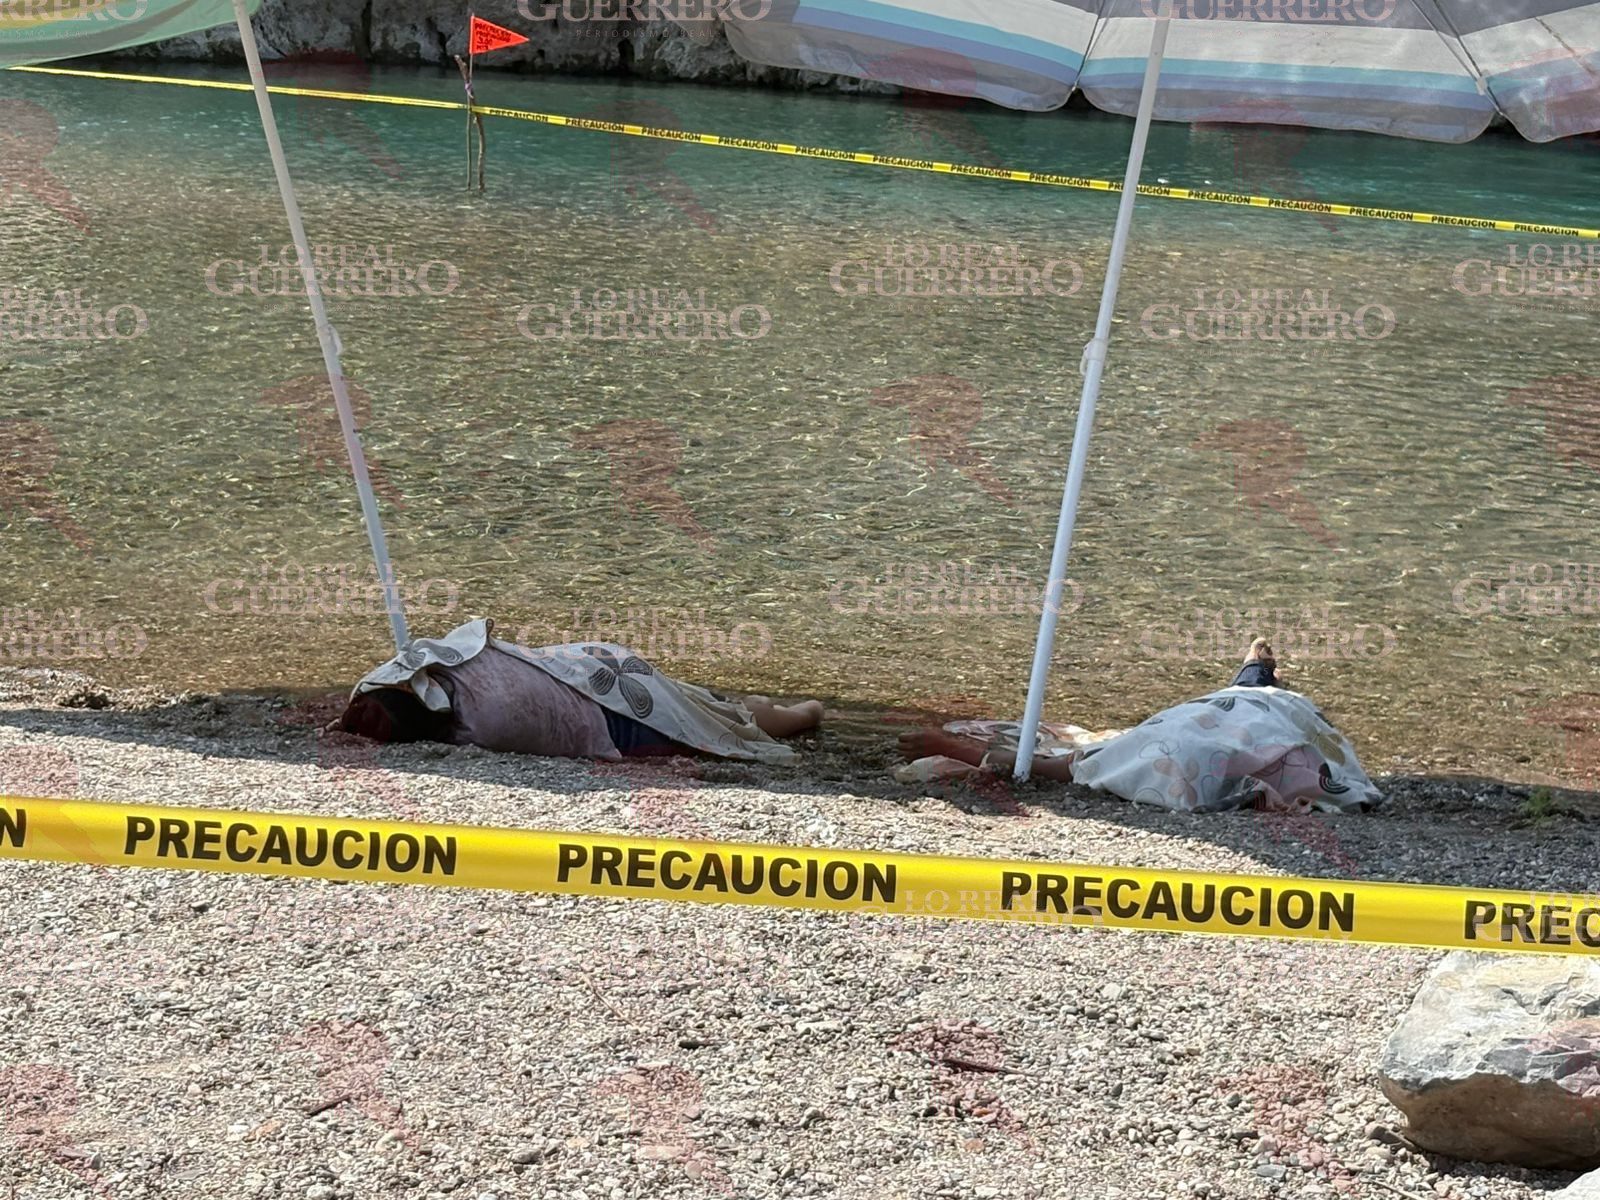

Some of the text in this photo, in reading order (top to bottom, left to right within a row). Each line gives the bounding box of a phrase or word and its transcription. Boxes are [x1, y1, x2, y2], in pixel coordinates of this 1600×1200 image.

[565, 118, 625, 132] PRECAUCION
[641, 127, 701, 141] PRECAUCION
[718, 137, 778, 151] PRECAUCION
[795, 146, 856, 160] PRECAUCION
[873, 155, 933, 169] PRECAUCION
[950, 165, 1012, 178] PRECAUCION
[1029, 173, 1091, 187] PRECAUCION
[1108, 182, 1171, 196] PRUCION
[1187, 190, 1251, 204] PRECAUCION
[1268, 199, 1332, 213] PRECAUCION
[1349, 207, 1414, 221] PRECAUCION
[1431, 215, 1496, 229] PRECAUCION
[1514, 224, 1579, 237] PRECAUCION
[0, 808, 27, 848] N
[124, 816, 457, 876] PRECAUCION
[557, 843, 896, 903] PRECAUCION
[1001, 871, 1355, 932] PRECAUCION
[1464, 900, 1600, 947] PREC
